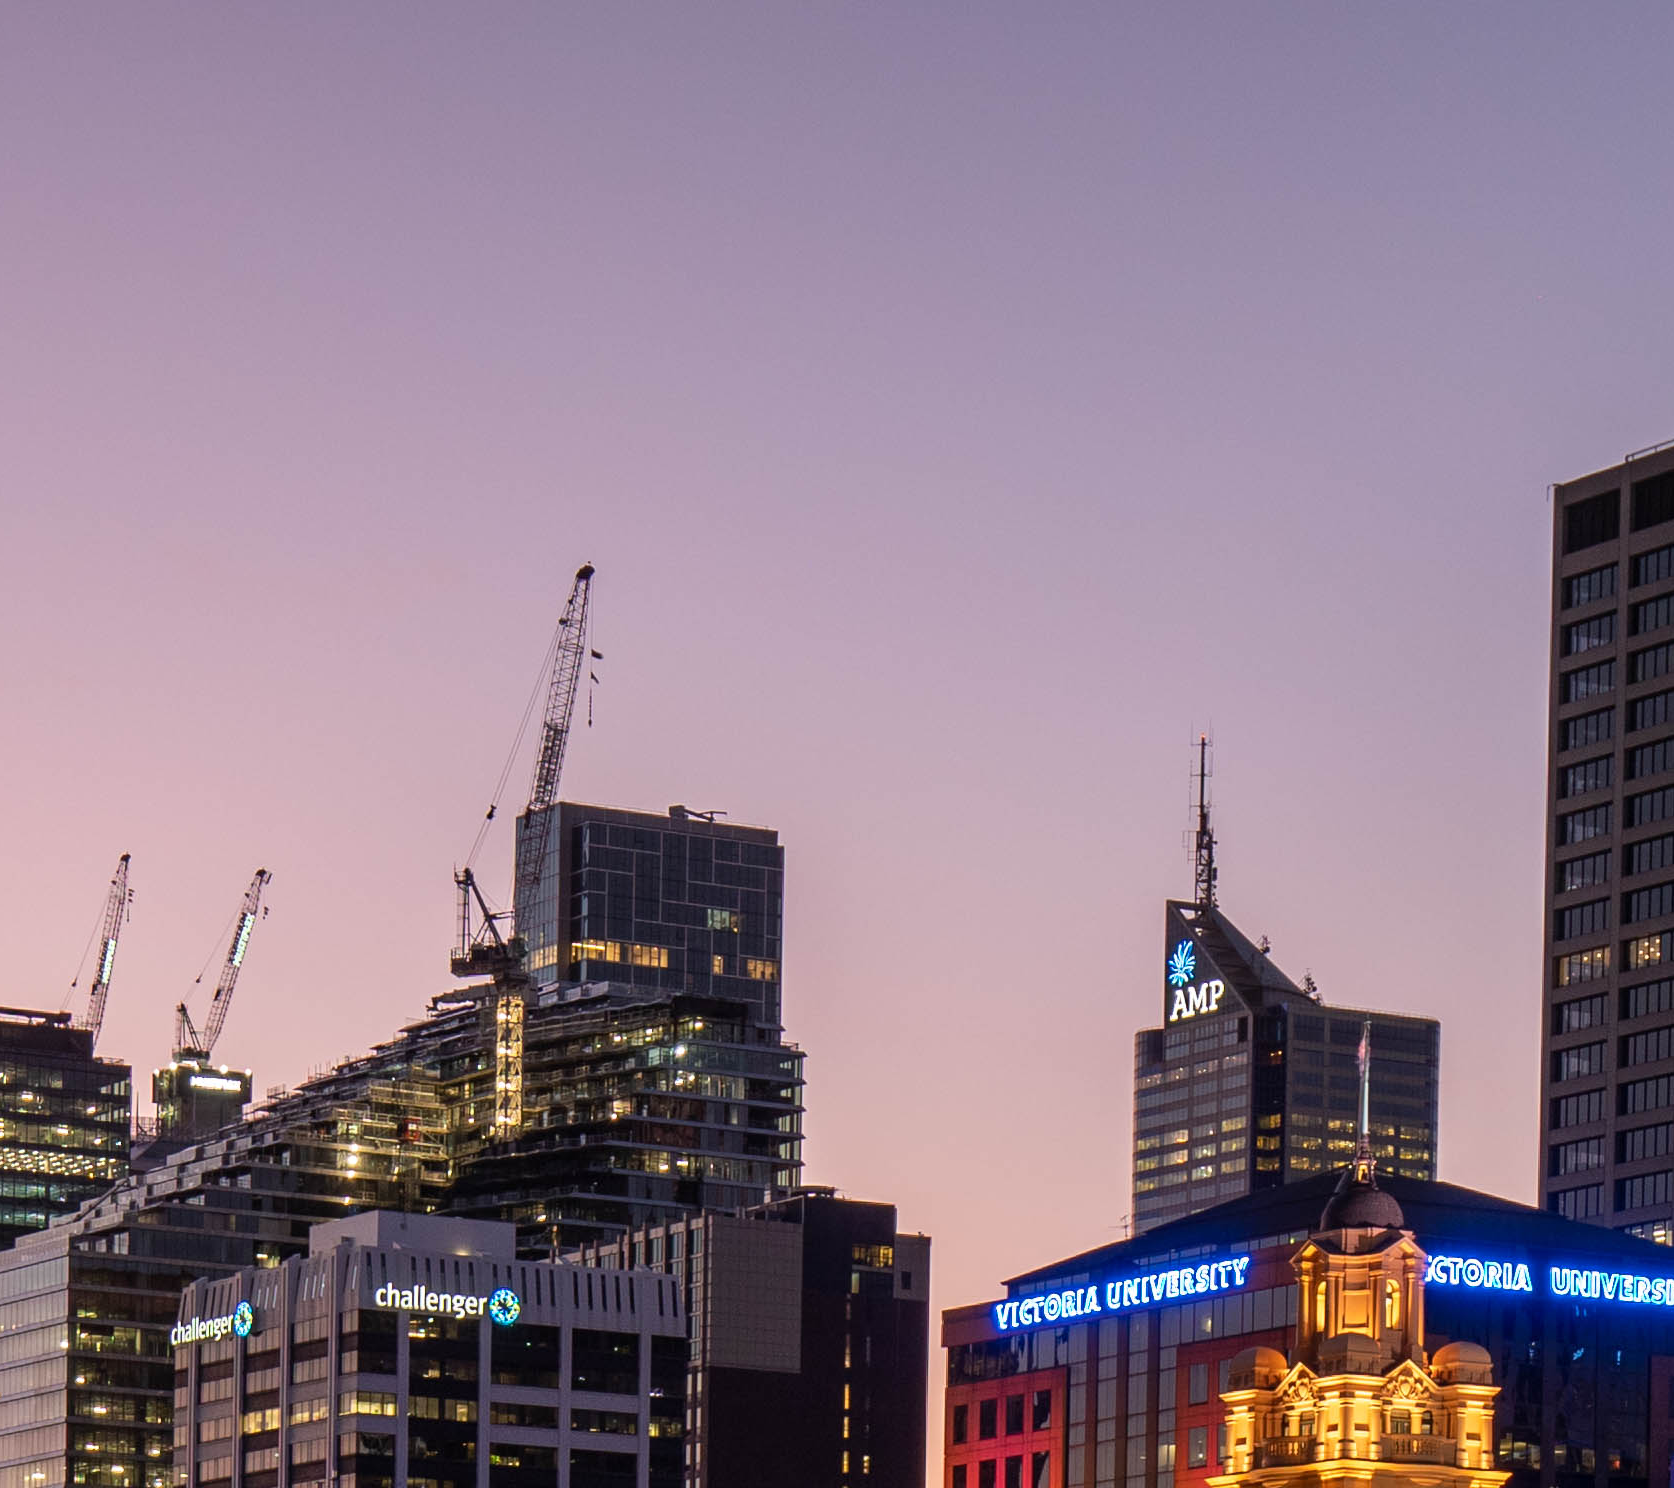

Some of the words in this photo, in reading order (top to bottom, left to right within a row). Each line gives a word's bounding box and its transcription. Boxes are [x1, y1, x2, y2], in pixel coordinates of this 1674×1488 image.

[1169, 979, 1225, 1022] AMP
[374, 1282, 489, 1319] challenger
[995, 1285, 1102, 1330] VICTORIA
[1106, 1256, 1250, 1310] UNIVERSITY
[170, 1312, 235, 1346] challenger
